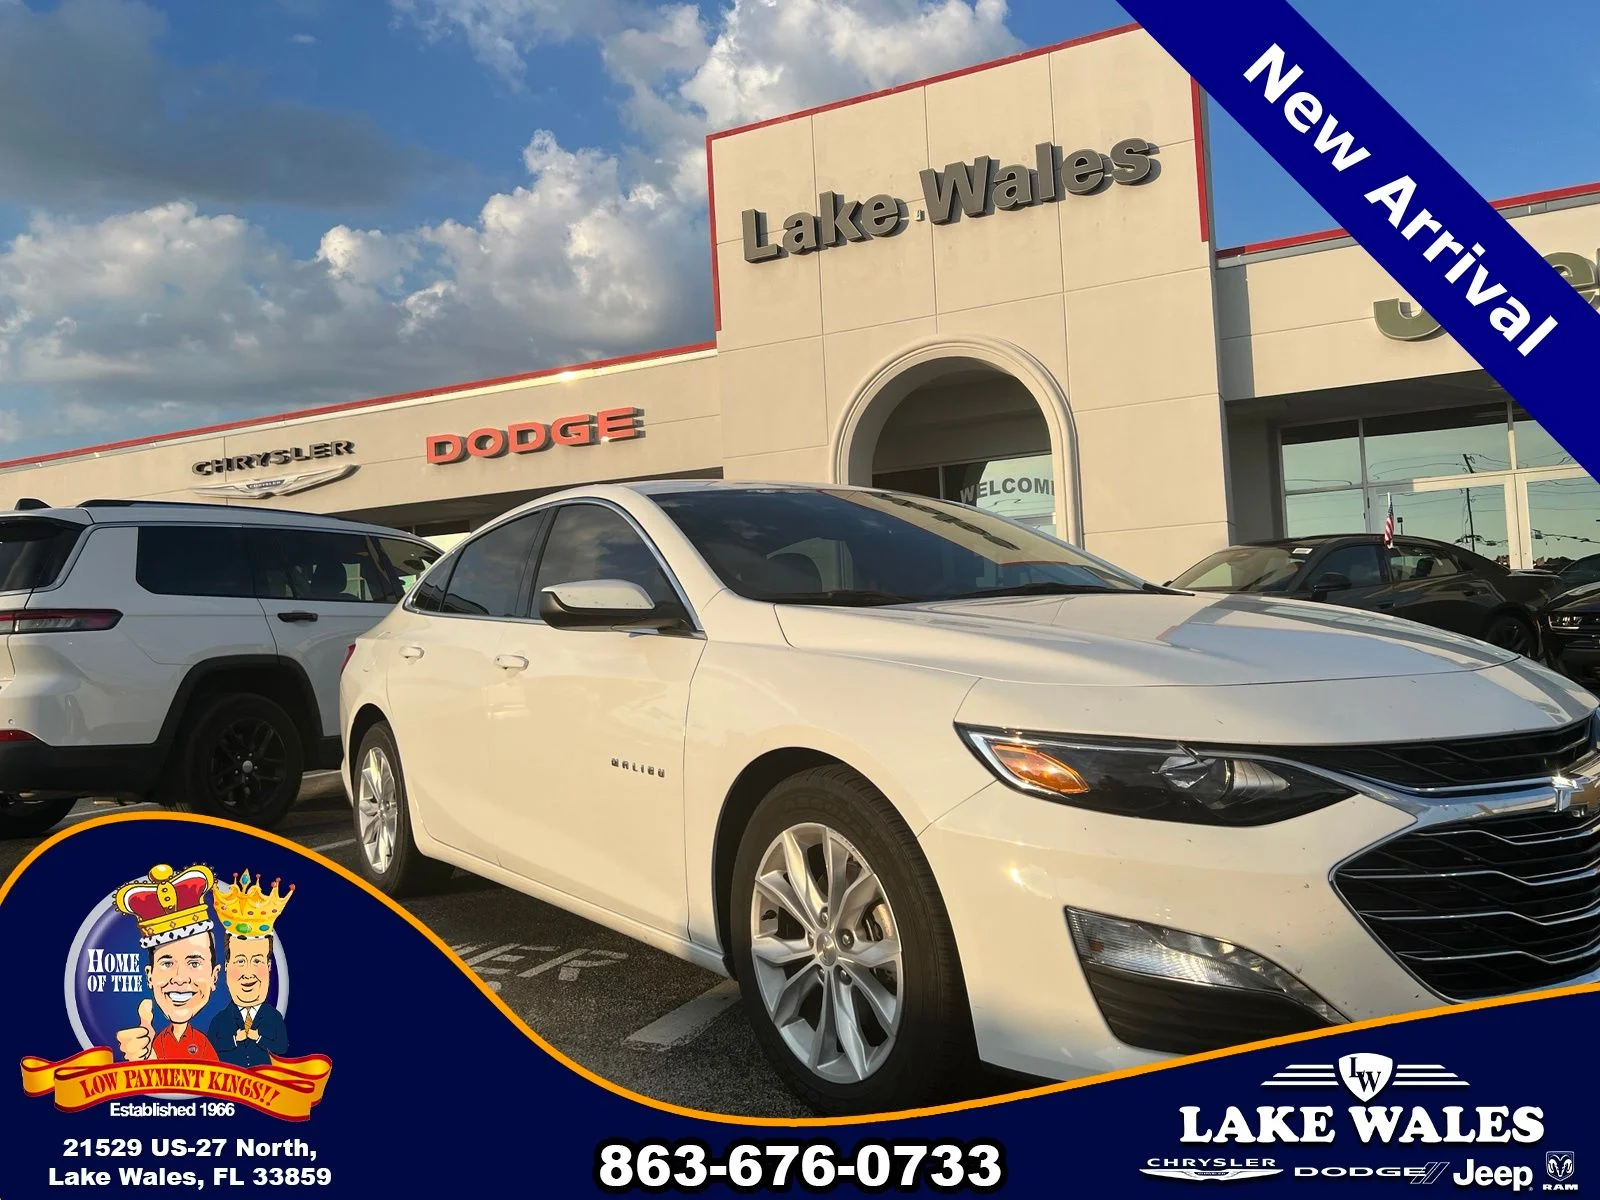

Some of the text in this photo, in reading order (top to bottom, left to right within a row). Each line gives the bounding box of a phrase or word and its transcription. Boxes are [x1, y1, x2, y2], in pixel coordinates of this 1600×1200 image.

[742, 137, 1159, 262] Lake Wales
[426, 407, 644, 465] DODGE
[192, 440, 355, 475] CHRYSLER
[960, 477, 1056, 503] WELCOM
[611, 758, 665, 778] MALIBU
